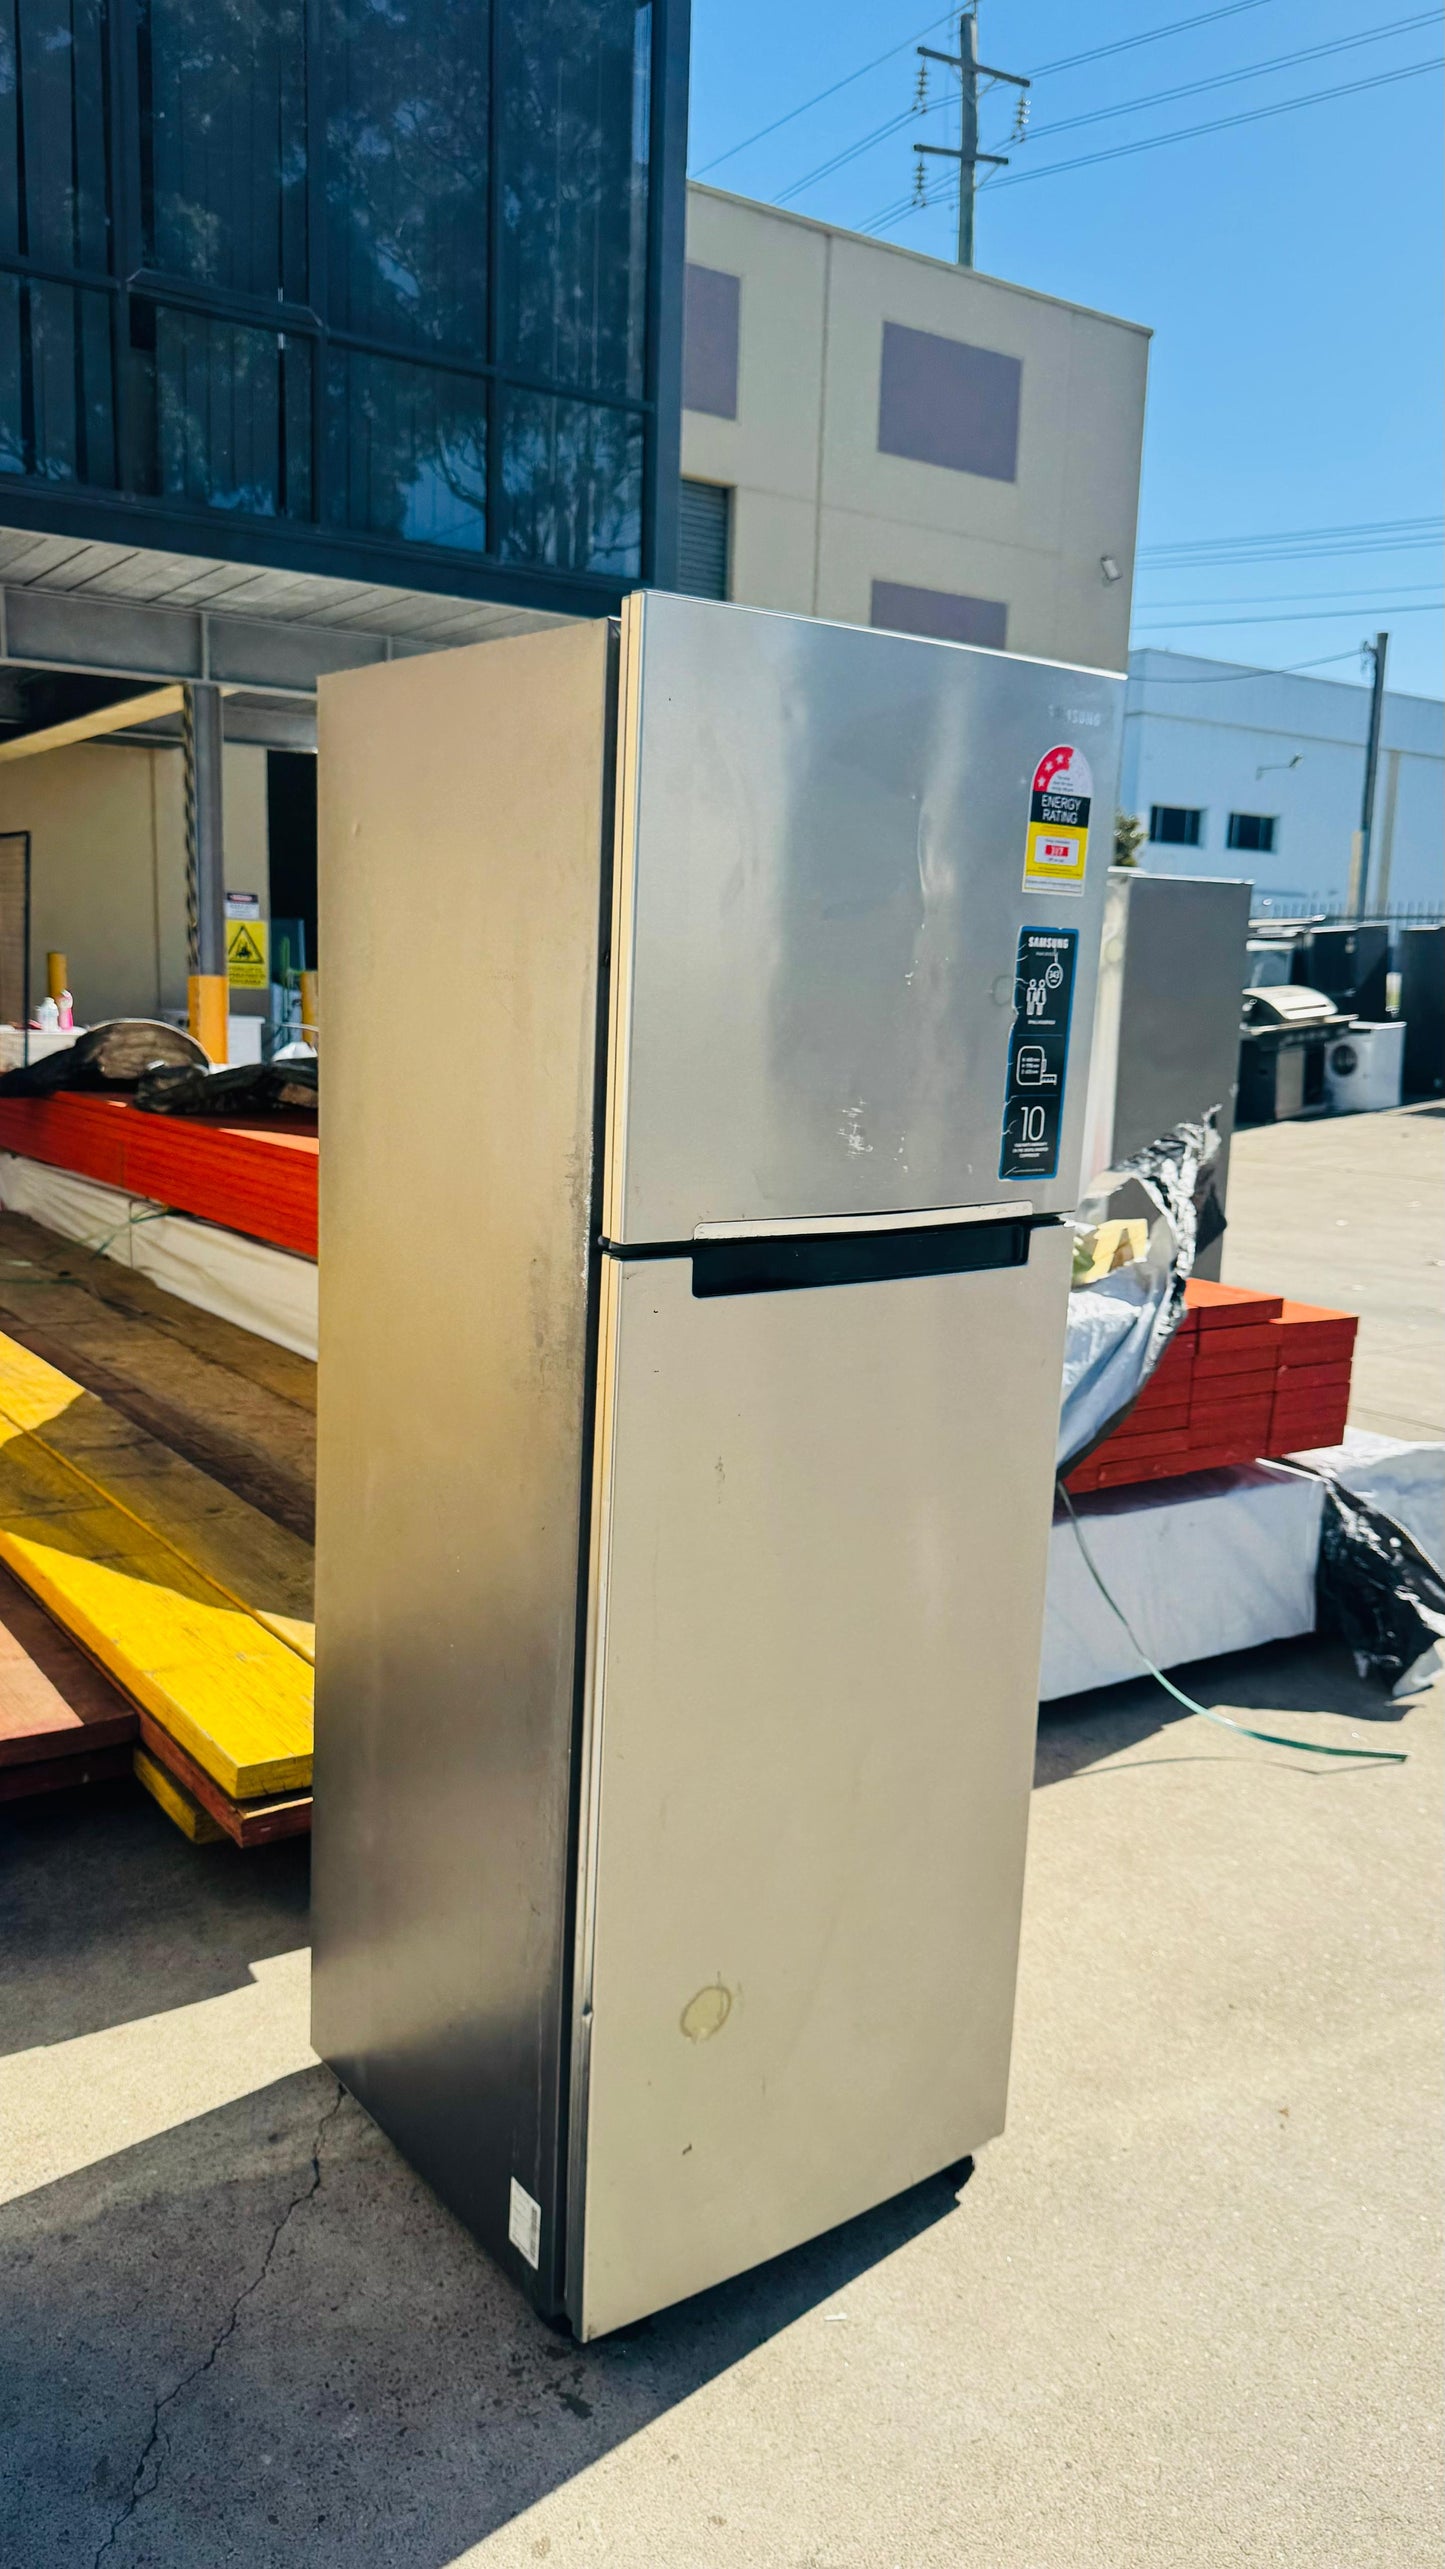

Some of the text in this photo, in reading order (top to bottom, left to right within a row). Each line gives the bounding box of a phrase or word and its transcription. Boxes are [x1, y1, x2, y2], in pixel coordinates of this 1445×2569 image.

[1048, 704, 1101, 727] SSUNG
[1041, 794, 1082, 811] ENERGY
[1042, 809, 1078, 825] RATING
[1028, 936, 1069, 949] SAMSUNG
[1020, 1105, 1046, 1142] 10
